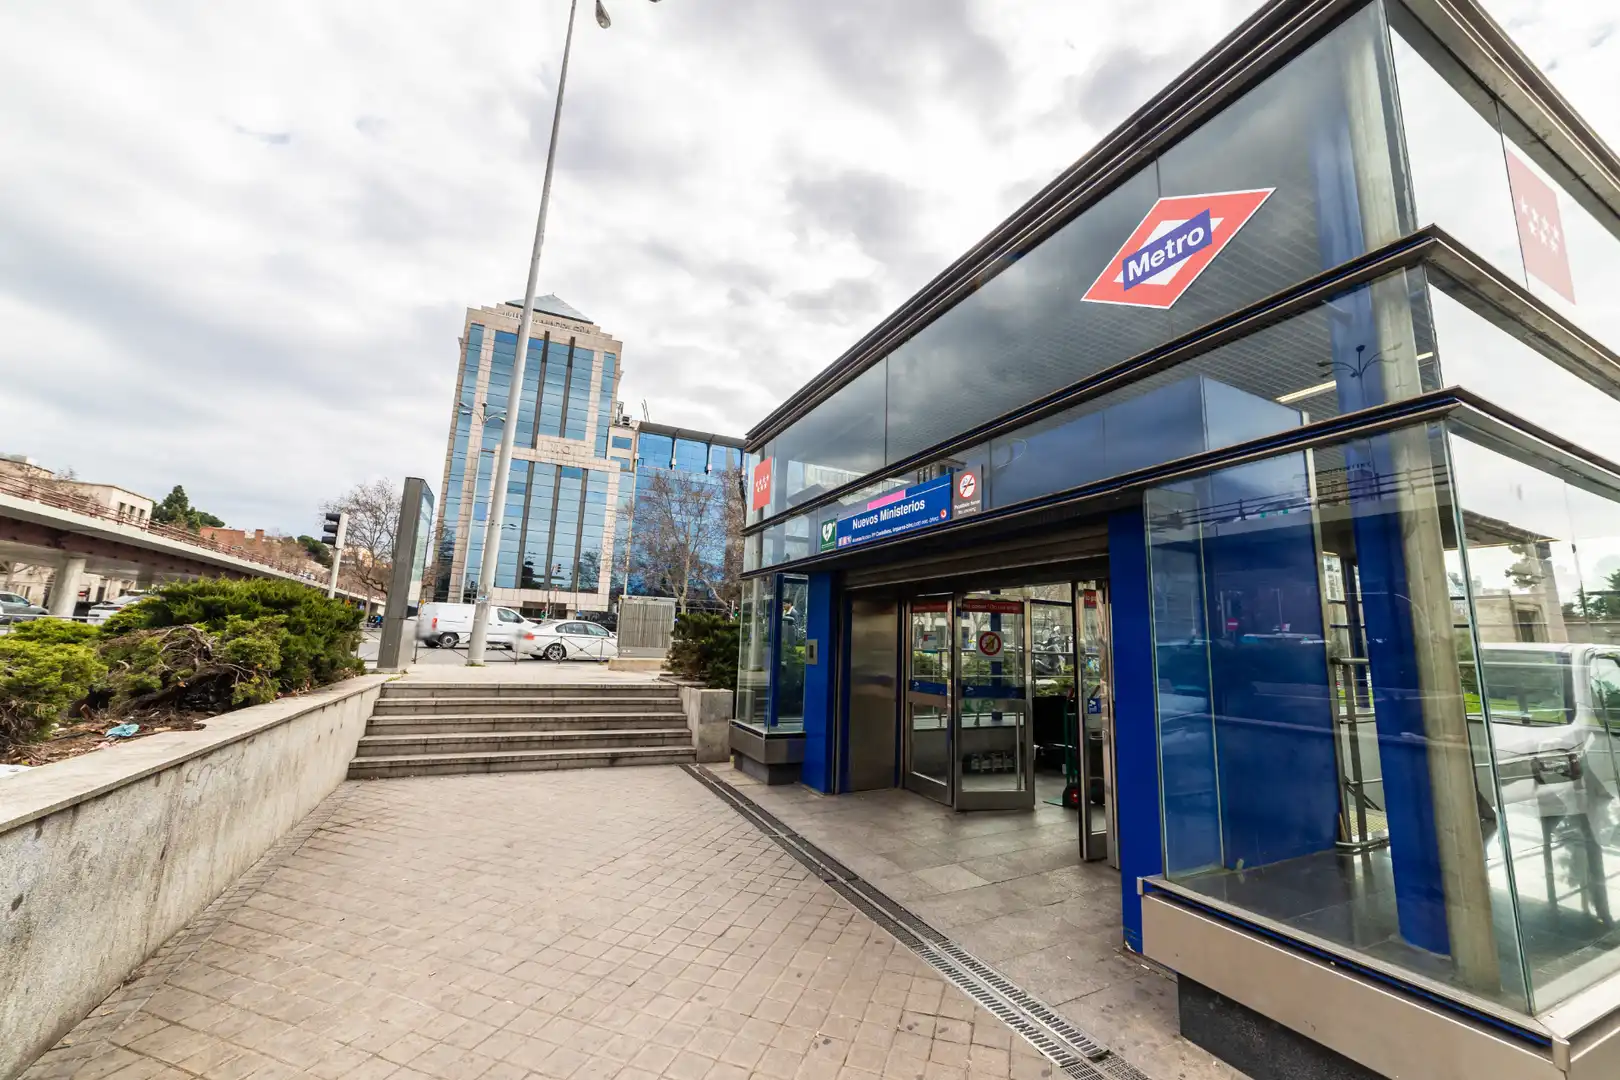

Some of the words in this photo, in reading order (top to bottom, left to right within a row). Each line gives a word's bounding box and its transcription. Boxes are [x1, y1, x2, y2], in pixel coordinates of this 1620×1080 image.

[1128, 226, 1205, 282] Metro
[852, 514, 879, 530] Nuevos
[880, 499, 926, 522] Ministerios
